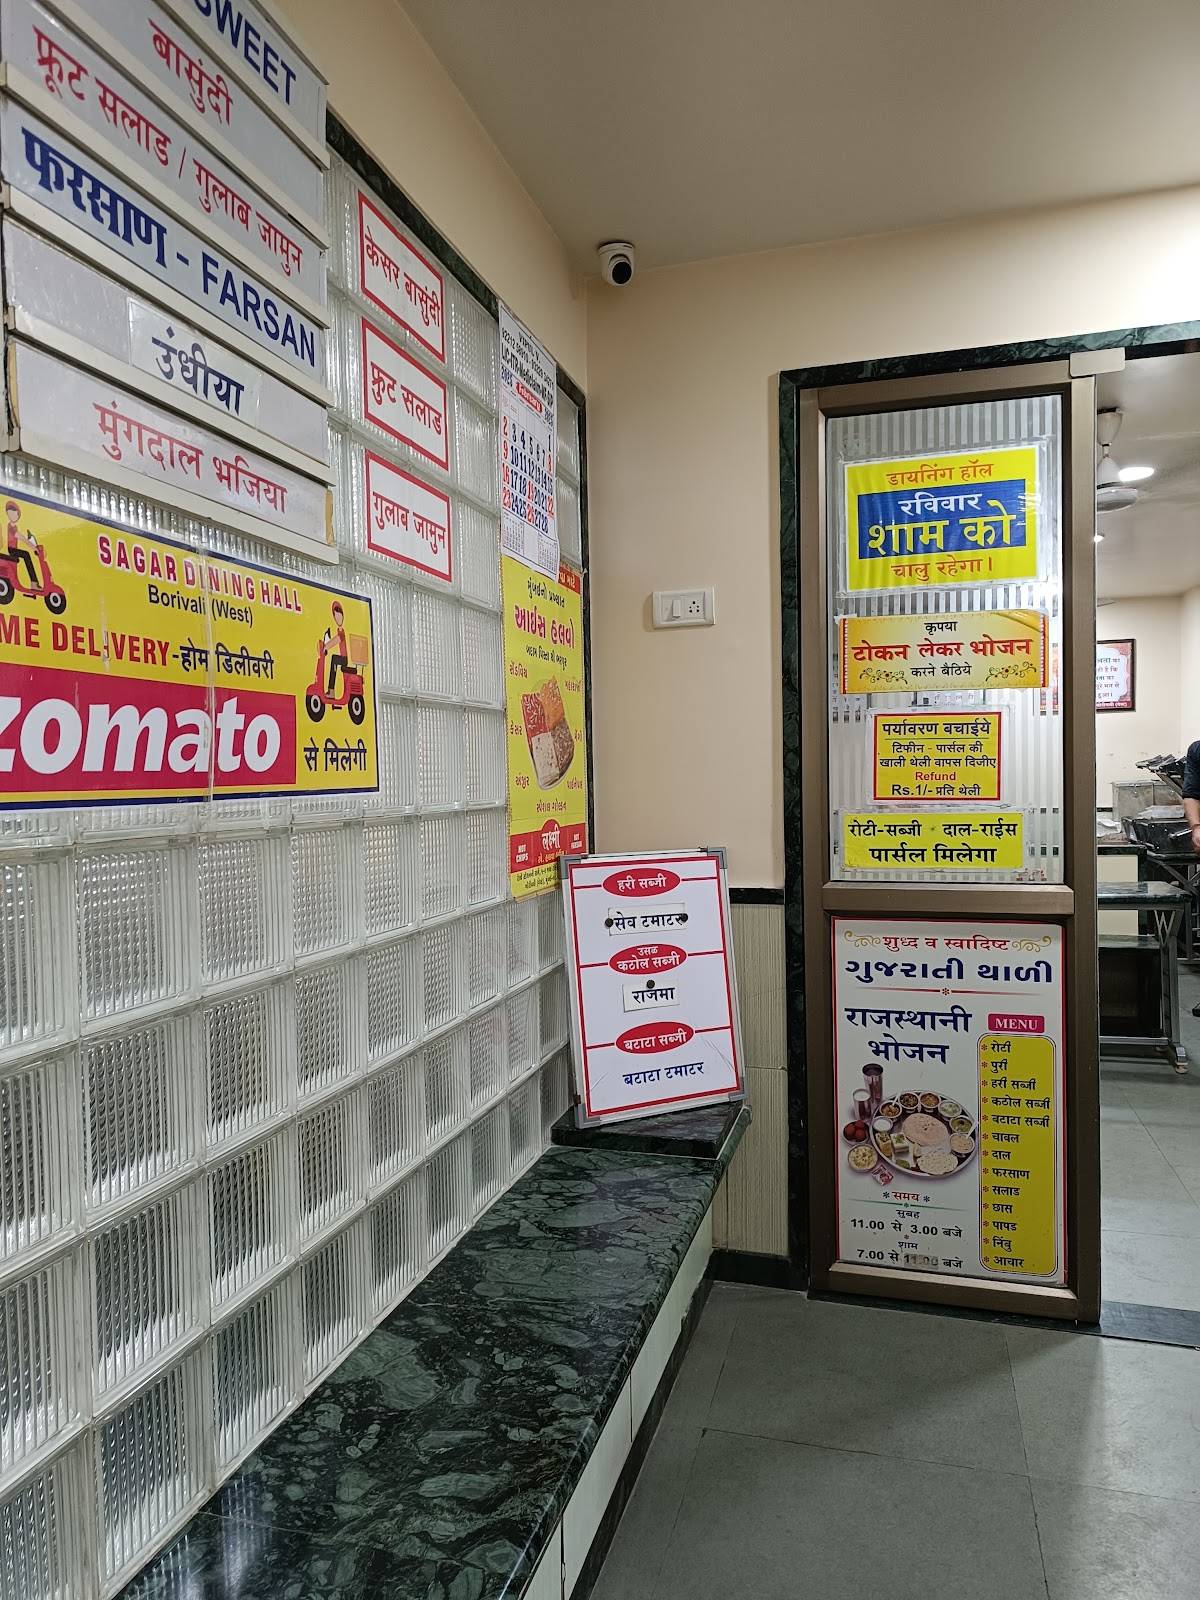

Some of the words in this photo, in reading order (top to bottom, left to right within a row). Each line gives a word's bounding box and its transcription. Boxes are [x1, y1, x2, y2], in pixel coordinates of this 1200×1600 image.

[148, 18, 233, 125] बासुंदी
[95, 76, 171, 166] सलाड
[192, 157, 251, 232] गुलाब
[255, 209, 303, 277] जामुन
[21, 126, 167, 268] फरसाण
[201, 250, 316, 368] FARSAN
[365, 225, 400, 290] केसर
[151, 326, 244, 415] उंधीया
[400, 384, 442, 435] सलाड
[503, 416, 508, 436] 2
[511, 423, 517, 443] 3
[520, 430, 526, 450] 4
[93, 400, 204, 481] मुंगदाल
[212, 455, 288, 513] भजिया
[503, 440, 508, 460] 9
[510, 445, 519, 467] 10
[520, 452, 527, 474] 11
[528, 458, 534, 479] 12
[502, 462, 510, 485] 16
[510, 469, 518, 490] 17
[519, 475, 527, 497] 18
[886, 463, 955, 486] डायनिंग
[959, 459, 994, 481] हॉल
[511, 492, 519, 514] 24
[519, 498, 527, 519] 25
[898, 492, 982, 516] रविवार
[372, 491, 409, 531] गुलाब
[413, 511, 446, 554] जामुन
[868, 520, 949, 555] शाम
[959, 500, 1016, 547] को
[98, 535, 178, 583] SAGAR
[183, 559, 255, 602] DINING
[260, 580, 303, 613] HALL
[891, 562, 930, 581] चालु
[148, 584, 206, 616] Borivali
[211, 598, 253, 628] (West)
[550, 618, 575, 650] હલવો
[924, 621, 958, 635] कृपया
[851, 640, 911, 661] टोकन
[917, 638, 964, 657] लेकर
[970, 634, 1032, 656] भोजन
[215, 642, 274, 680] डिलीवरी
[910, 662, 936, 677] करने
[941, 661, 972, 676] बैठिये
[0, 696, 281, 774] zomato
[882, 719, 938, 735] पर्यावरण
[943, 718, 991, 736] बचाईये
[304, 736, 319, 771] से
[324, 737, 367, 771] मिलेगी
[892, 742, 924, 753] टिफीन
[936, 741, 965, 753] पार्सल
[969, 741, 983, 752] की
[880, 756, 906, 767] खाली
[910, 755, 931, 767] थेली
[934, 758, 962, 767] वापस
[965, 755, 996, 768] दिजीए
[915, 772, 956, 780] Refund
[936, 784, 954, 796] प्रति
[959, 784, 980, 796] थेली
[869, 842, 927, 862] पार्सल
[933, 843, 997, 862] मिलेगा
[617, 875, 635, 892] हरी
[638, 873, 667, 889] सब्जी
[614, 911, 637, 931] सेव
[925, 938, 938, 949] व
[944, 935, 1011, 951] स्वादिष्ट
[617, 955, 649, 972] कठोल
[652, 951, 680, 968] सब्जी
[845, 958, 964, 983] ગુજરાતી
[977, 960, 1052, 983] થાળી
[632, 988, 675, 1004] राजमा
[845, 1005, 972, 1032] राजस्थानी
[995, 1018, 1038, 1030] MENU
[623, 1036, 656, 1050] बटाटा
[658, 1027, 687, 1046] सब्जी
[868, 1033, 949, 1064] भोजन
[991, 1041, 1011, 1052] रोटी
[622, 1069, 661, 1085] बटाटा
[664, 1062, 704, 1078] टमाटर
[991, 1059, 1008, 1073] पुरी
[991, 1077, 1008, 1088] हरी
[1011, 1078, 1036, 1090] सब्जी
[991, 1095, 1021, 1107] कठोल
[1025, 1097, 1050, 1109] सब्जी
[1025, 1115, 1050, 1127] सब्जी
[992, 1132, 1020, 1142] चावल
[992, 1150, 1011, 1160] दाल
[992, 1168, 1030, 1179] फरसाण
[892, 1191, 919, 1201] समय
[992, 1185, 1020, 1196] सलाड
[896, 1209, 920, 1219] सुबह
[992, 1203, 1013, 1213] छास
[851, 1219, 885, 1230] 11.00
[891, 1220, 902, 1232] से
[910, 1225, 938, 1235] 3.00
[942, 1226, 962, 1238] बजे
[992, 1221, 1017, 1231] पापड
[898, 1241, 918, 1250] शाम
[857, 1249, 884, 1260] 7.00
[888, 1250, 899, 1262] से
[942, 1257, 963, 1268] बजे
